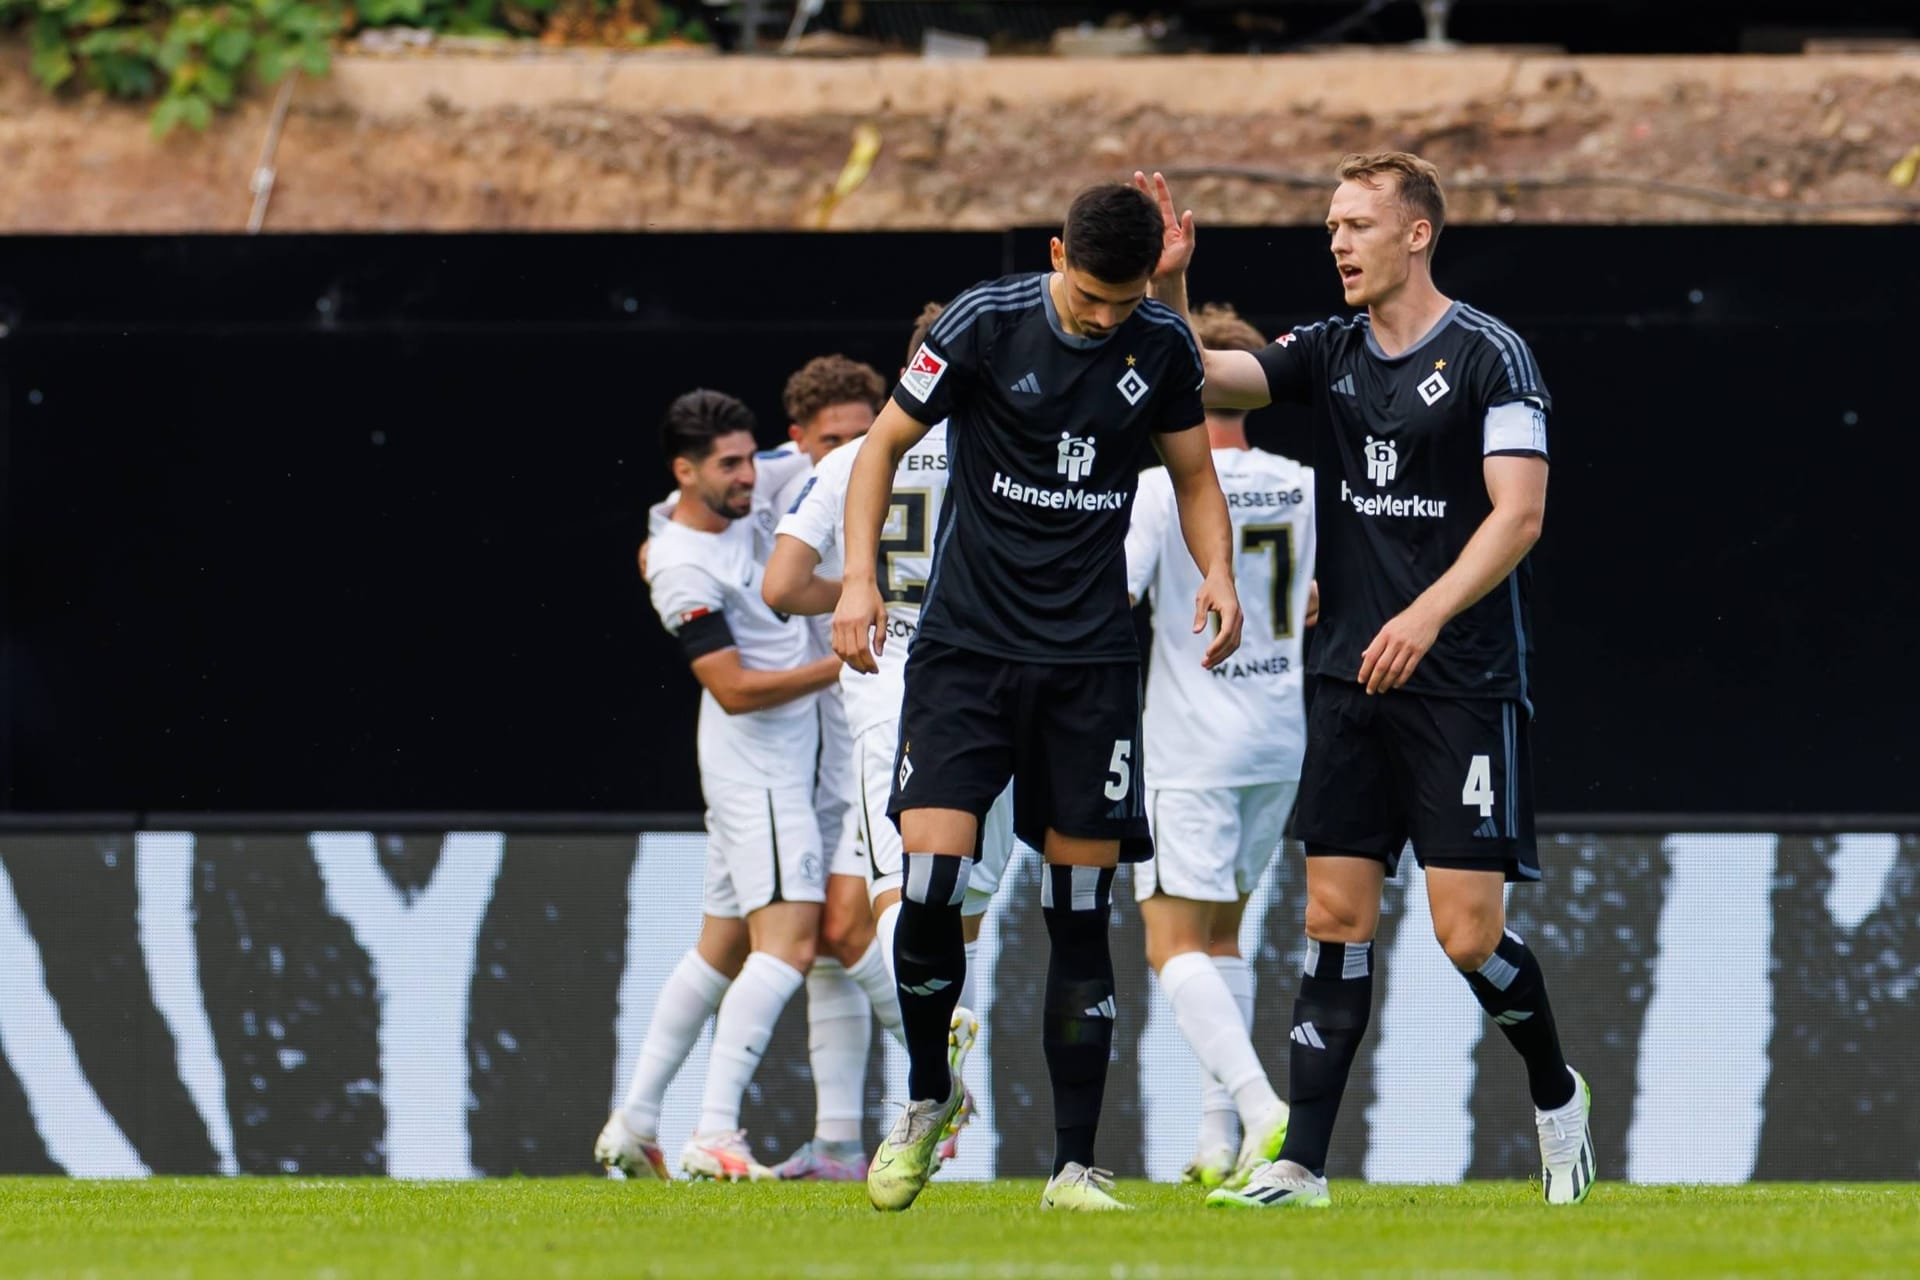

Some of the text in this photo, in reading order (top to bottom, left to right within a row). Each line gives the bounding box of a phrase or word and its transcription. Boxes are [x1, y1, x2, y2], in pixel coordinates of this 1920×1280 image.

[907, 454, 948, 471] ERS
[992, 471, 1127, 511] HanseMerku
[1229, 488, 1304, 508] RSBERG
[877, 487, 948, 609] 2
[886, 620, 917, 638] SCH
[1211, 656, 1290, 678] WANNER
[1104, 739, 1131, 801] 5
[1462, 755, 1495, 817] 4
